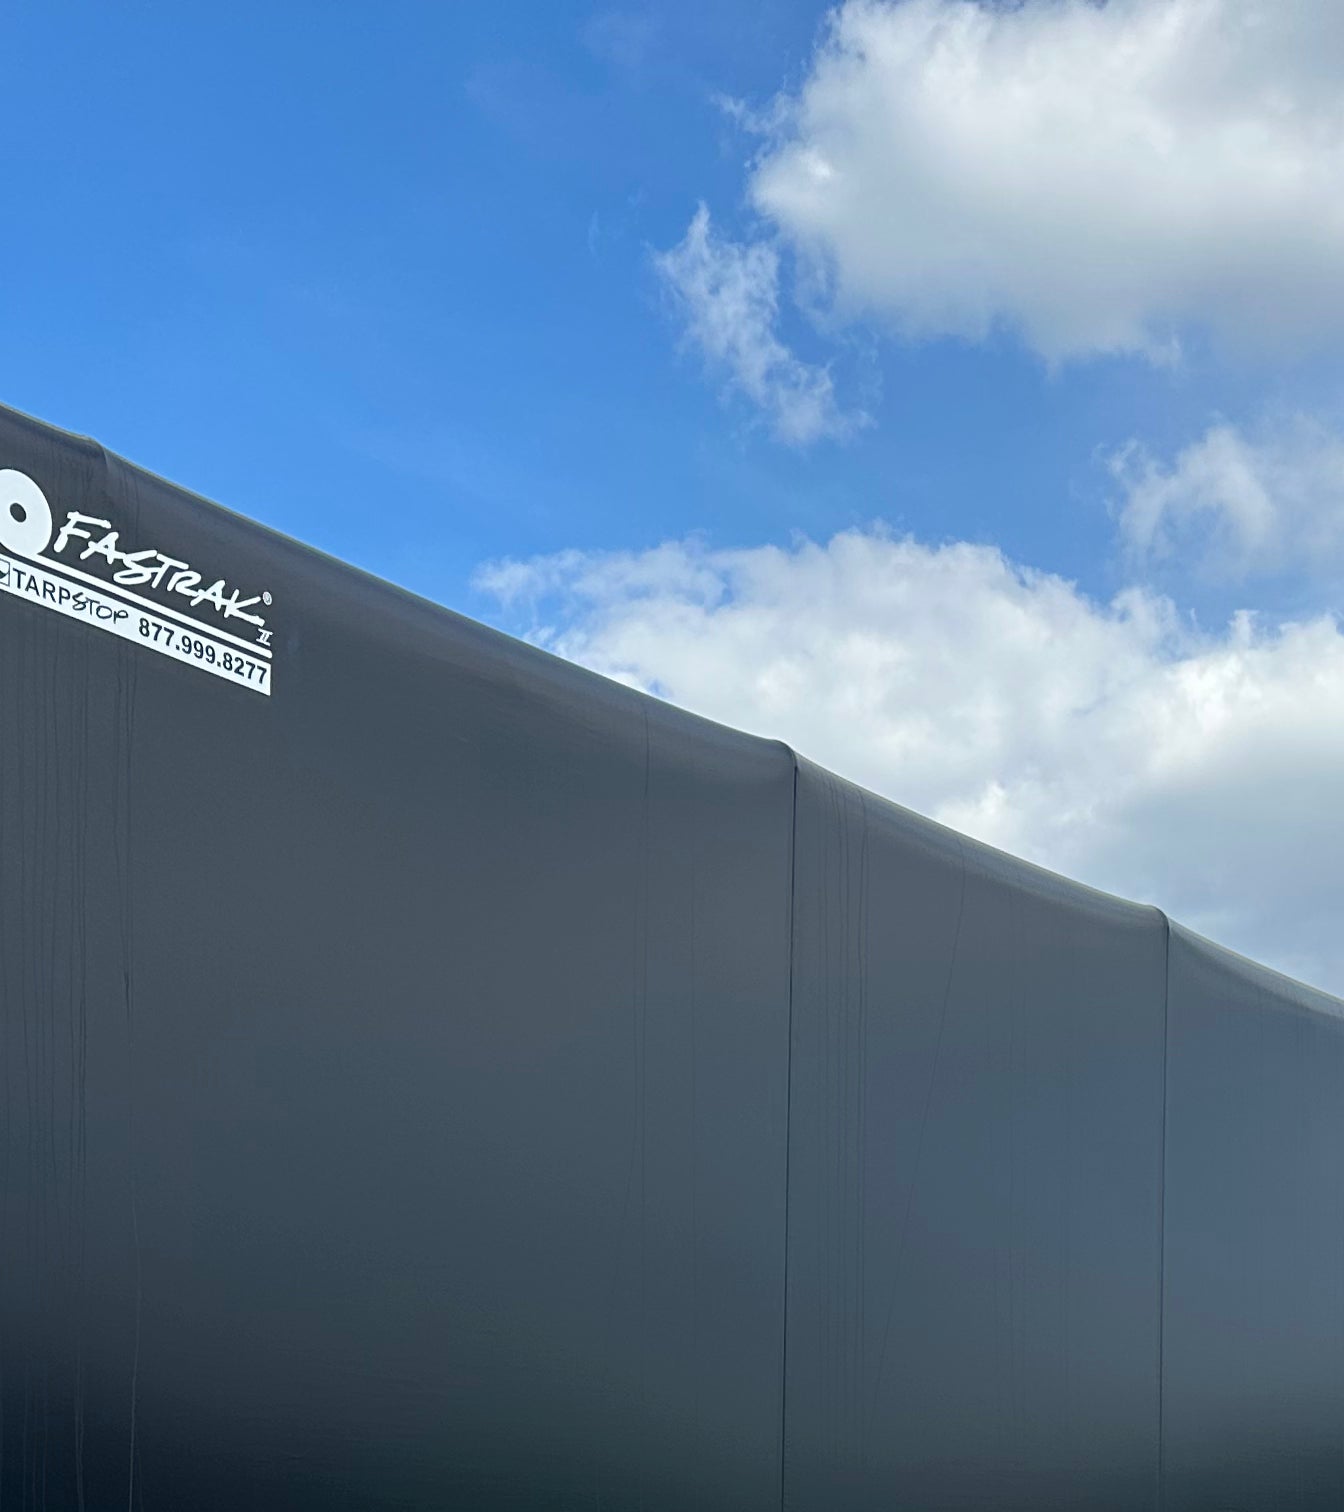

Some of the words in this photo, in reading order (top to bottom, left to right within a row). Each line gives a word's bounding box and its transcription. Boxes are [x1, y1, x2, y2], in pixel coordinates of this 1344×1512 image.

[11, 566, 130, 625] TARPSTOP
[138, 617, 269, 685] 877.999.8277
[53, 510, 266, 627] FASTRAK
